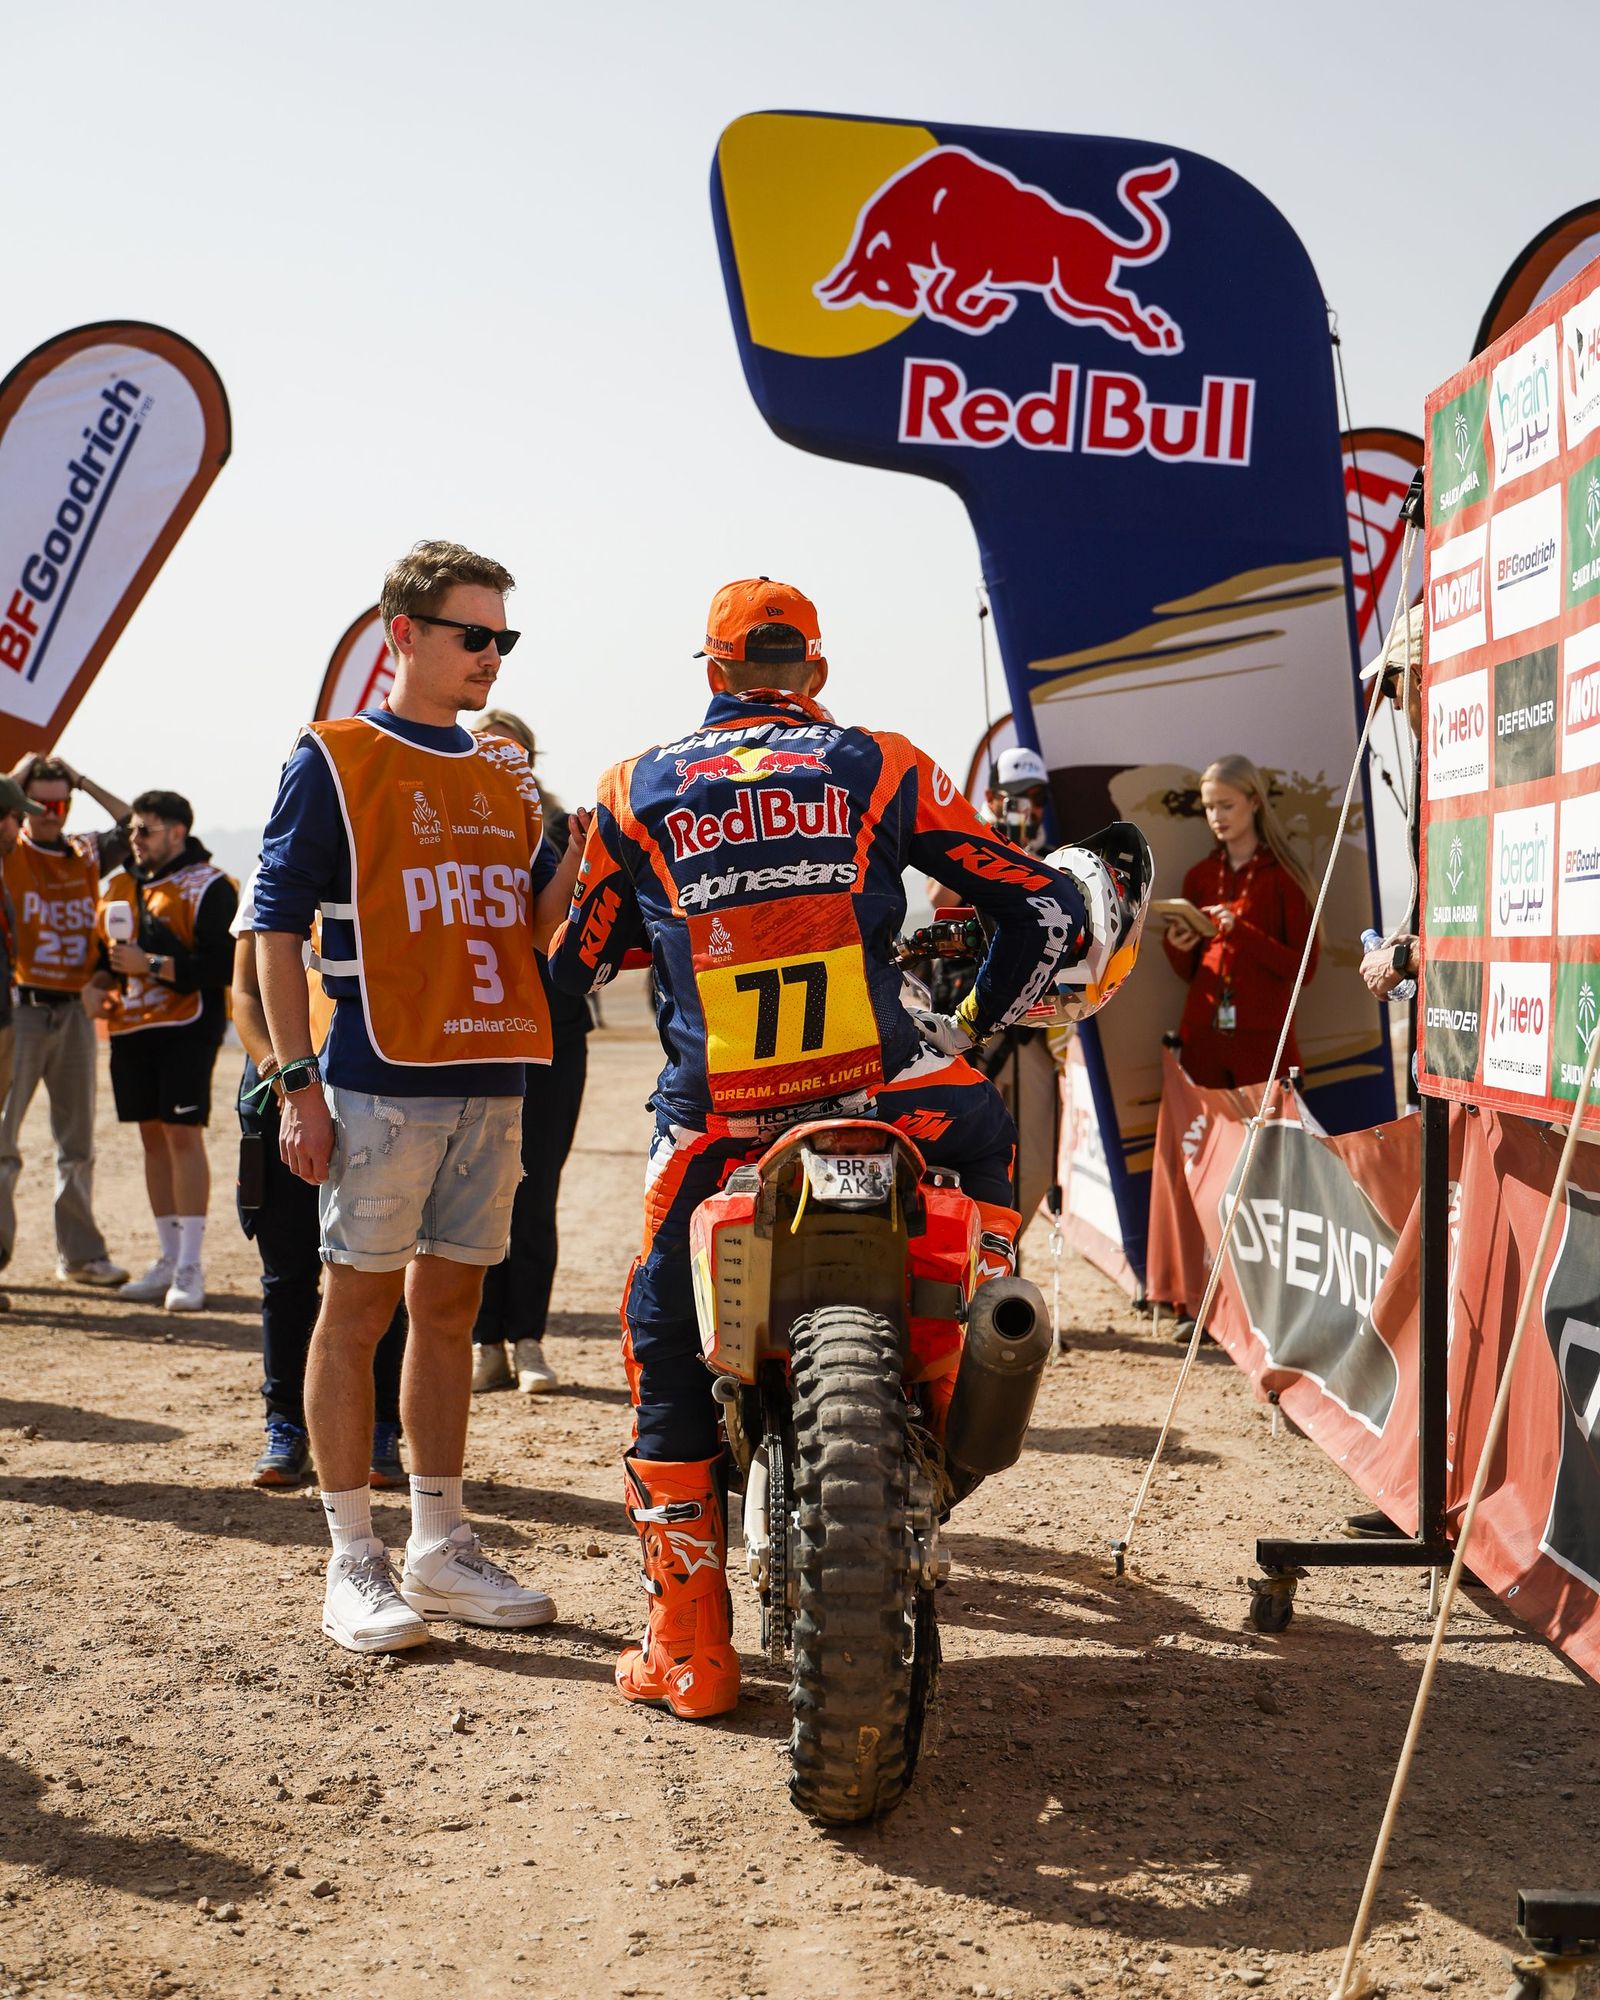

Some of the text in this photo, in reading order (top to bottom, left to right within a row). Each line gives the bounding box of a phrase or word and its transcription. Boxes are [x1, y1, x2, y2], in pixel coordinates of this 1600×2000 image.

[898, 357, 1255, 467] Red Bull
[0, 379, 141, 674] BFGoodrich
[1498, 538, 1556, 581] BFGoodrich
[1434, 568, 1479, 624] MOTUL
[1497, 700, 1554, 736] DEFENDER
[412, 821, 444, 836] DAKAR
[419, 836, 441, 845] 2026
[452, 825, 516, 840] SAUDI ARABIA
[665, 783, 851, 862] Red Bull
[945, 842, 1053, 892] KTM
[1500, 823, 1545, 885] berain
[678, 860, 858, 909] alpinestars
[579, 885, 621, 970] KTM
[1432, 905, 1478, 923] SAUDI ARABIA
[34, 931, 87, 966] 23
[708, 941, 735, 956] DAKAR
[712, 955, 732, 964] 2026
[466, 939, 505, 1004] 3
[443, 1017, 538, 1034] #Dakar2026
[735, 961, 828, 1060] 77
[1427, 1007, 1478, 1032] DEFENDER
[1509, 996, 1544, 1035] Hero
[714, 1060, 881, 1101] DREAM. DARE. LIVE IT.
[893, 1107, 957, 1141] KTM
[837, 1160, 865, 1176] BR
